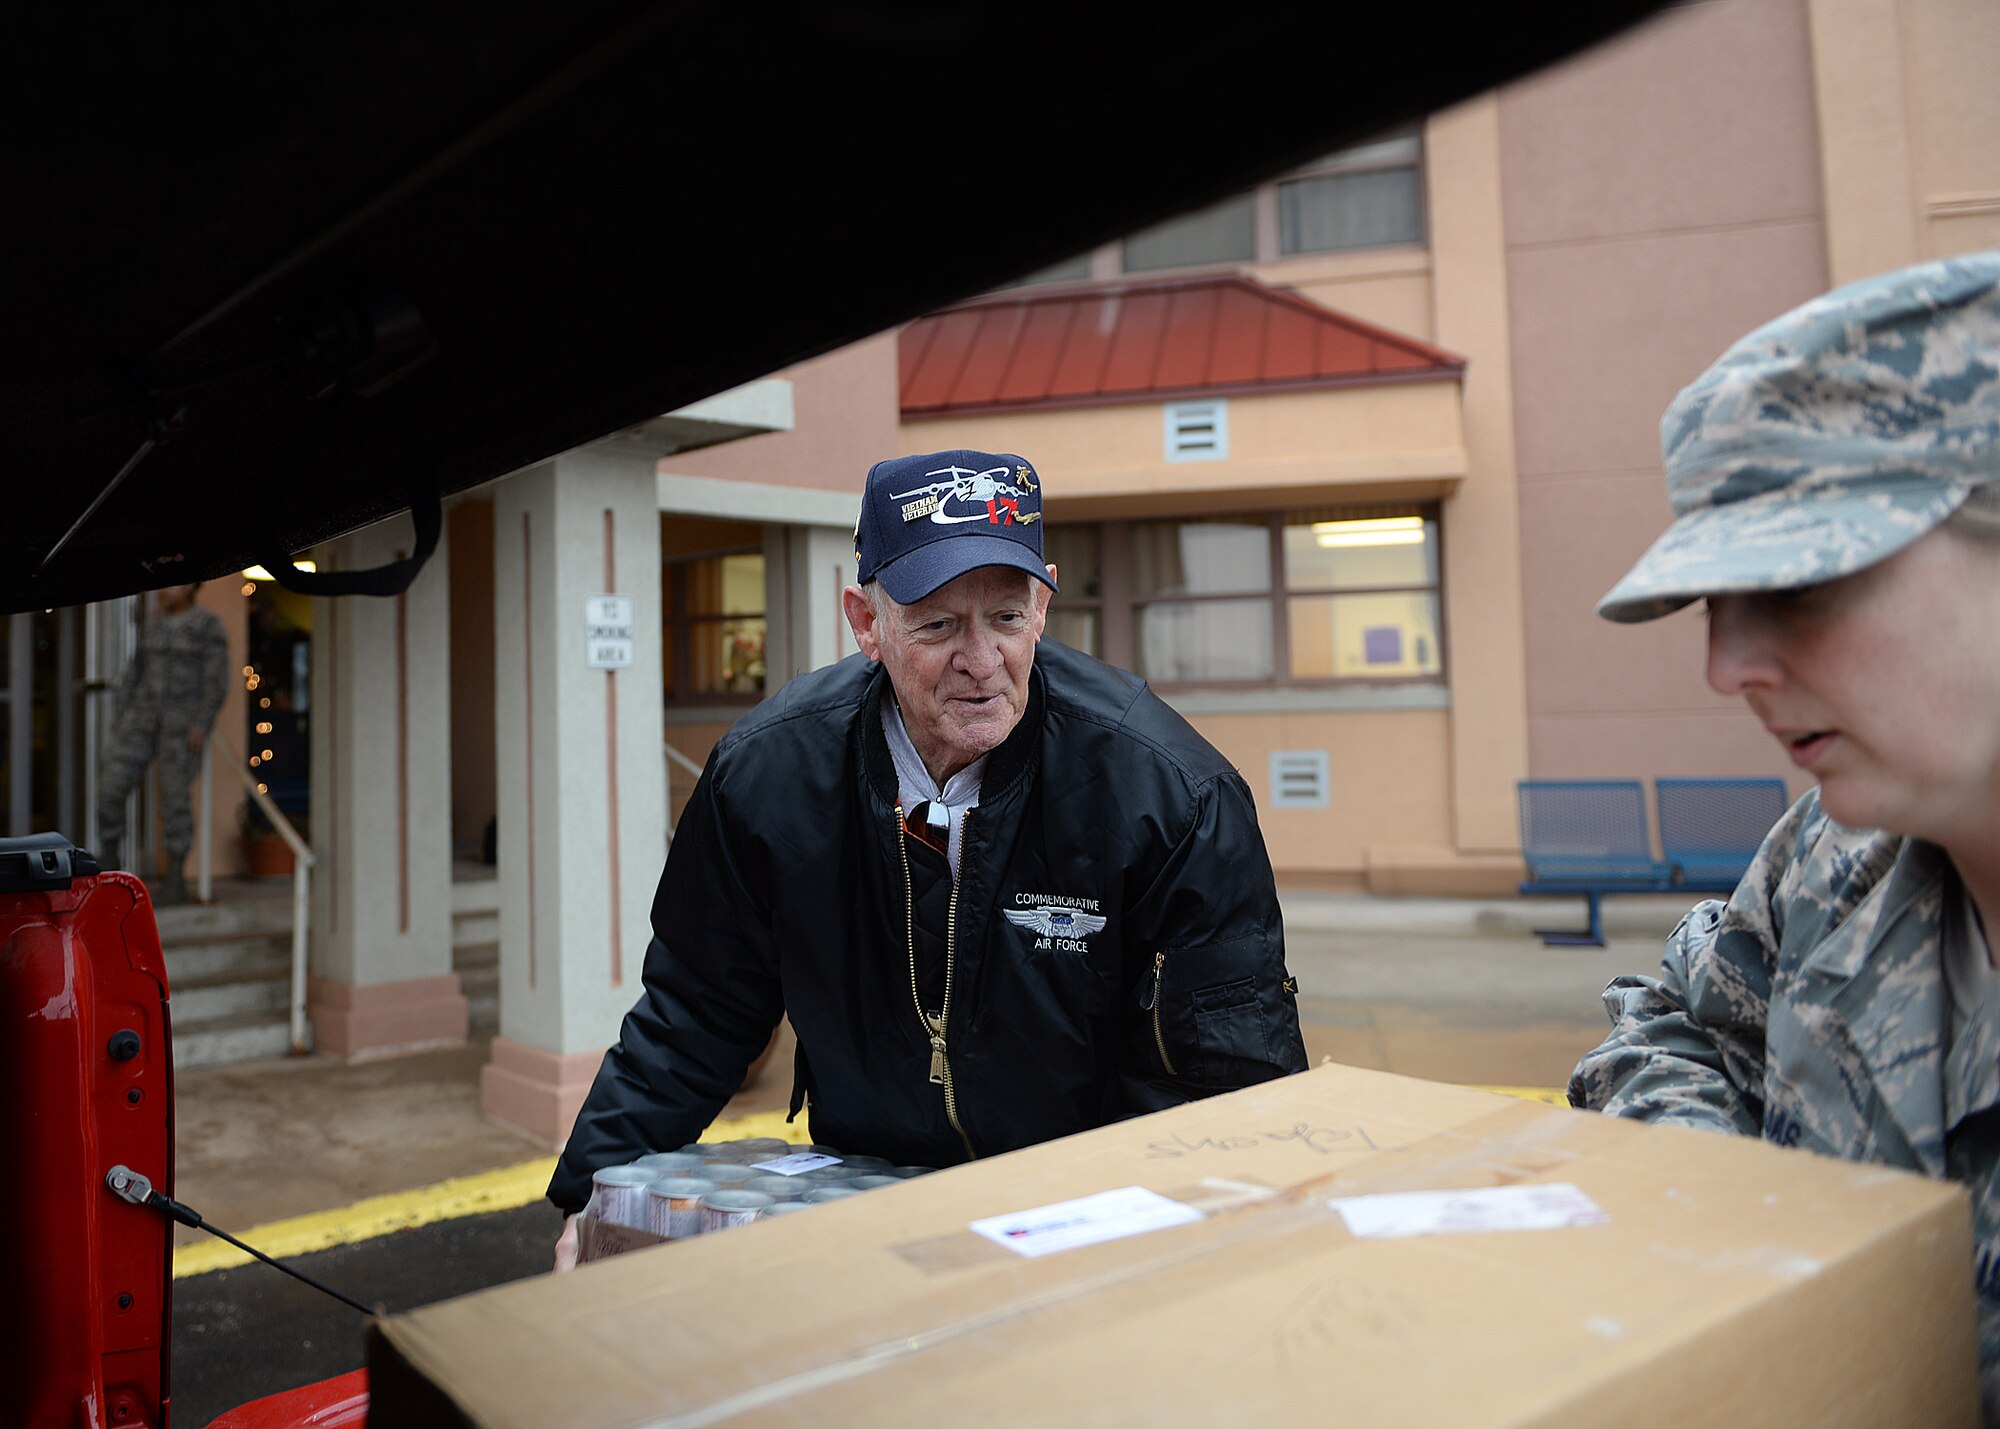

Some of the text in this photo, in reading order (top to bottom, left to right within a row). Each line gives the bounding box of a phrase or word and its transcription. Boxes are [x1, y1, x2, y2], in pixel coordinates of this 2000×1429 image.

[901, 495, 938, 514] VIETNAM
[902, 503, 939, 523] VETERAN
[1015, 892, 1100, 912] COMMEMORATIVE
[1034, 937, 1088, 953] AIR FORCE
